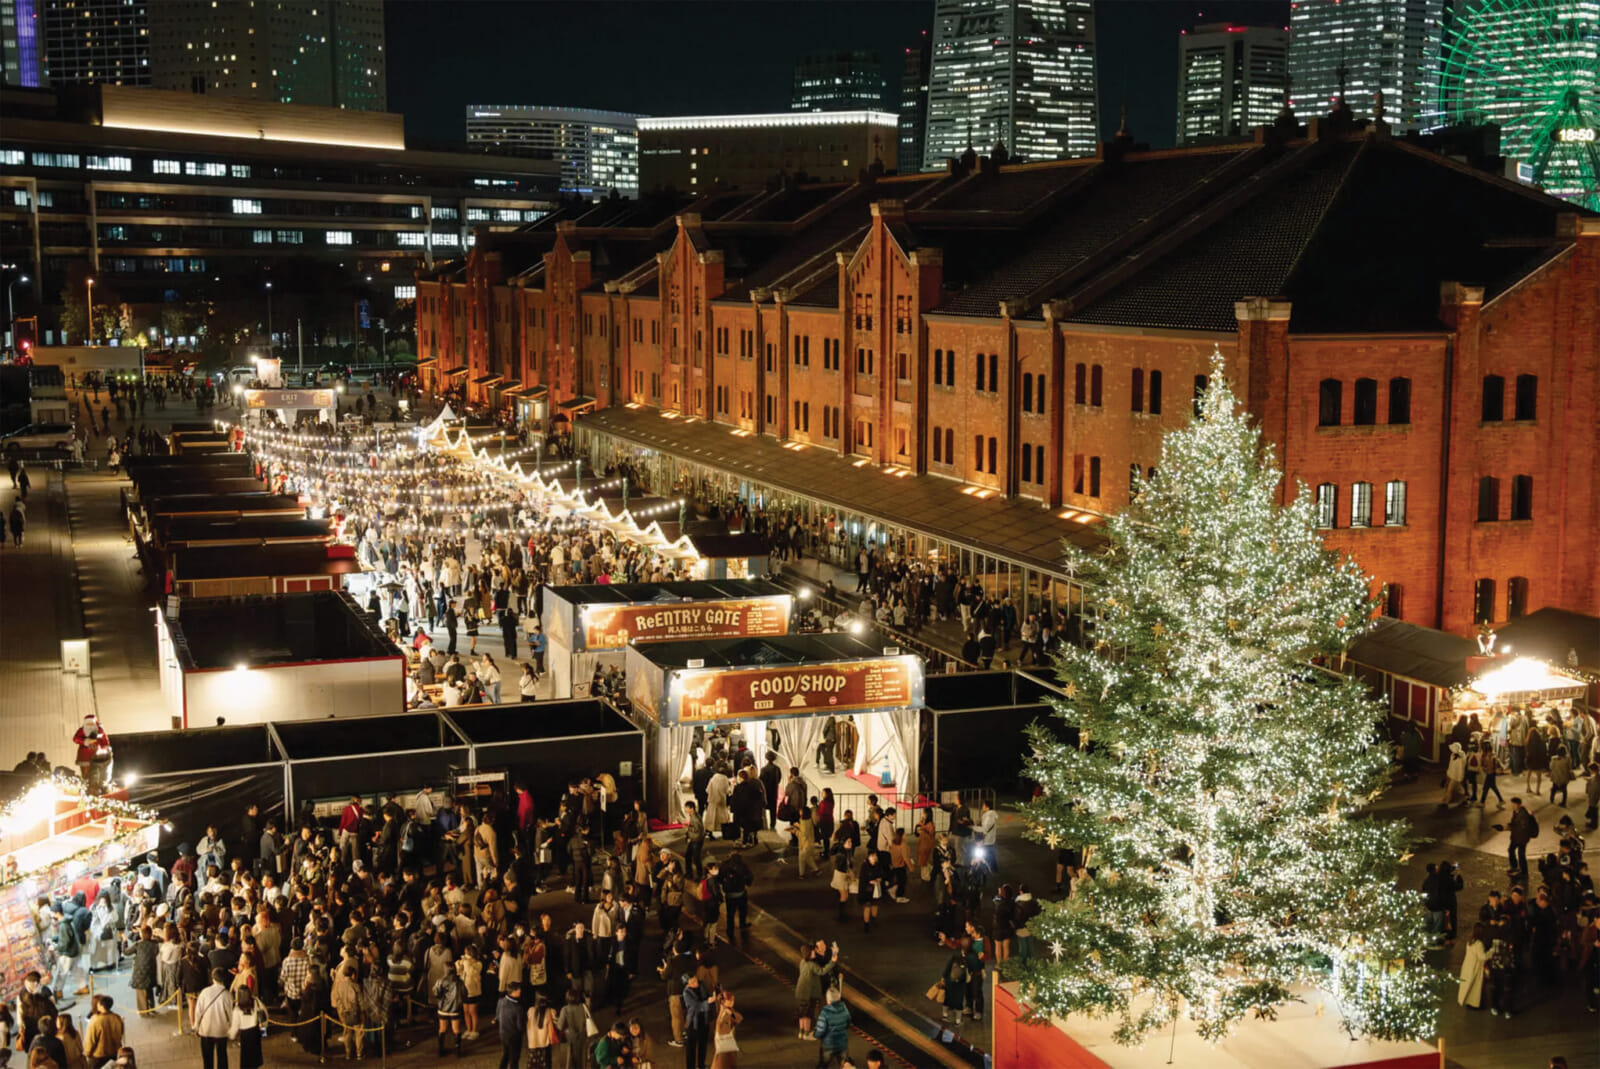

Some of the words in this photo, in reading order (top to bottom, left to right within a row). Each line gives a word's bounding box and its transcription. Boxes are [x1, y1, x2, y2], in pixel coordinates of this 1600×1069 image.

[1559, 128, 1595, 141] 18:50
[635, 609, 700, 631] ReENTRY
[705, 608, 741, 626] GATE
[750, 674, 846, 698] FOOD/SHOP
[755, 700, 773, 708] EXIT
